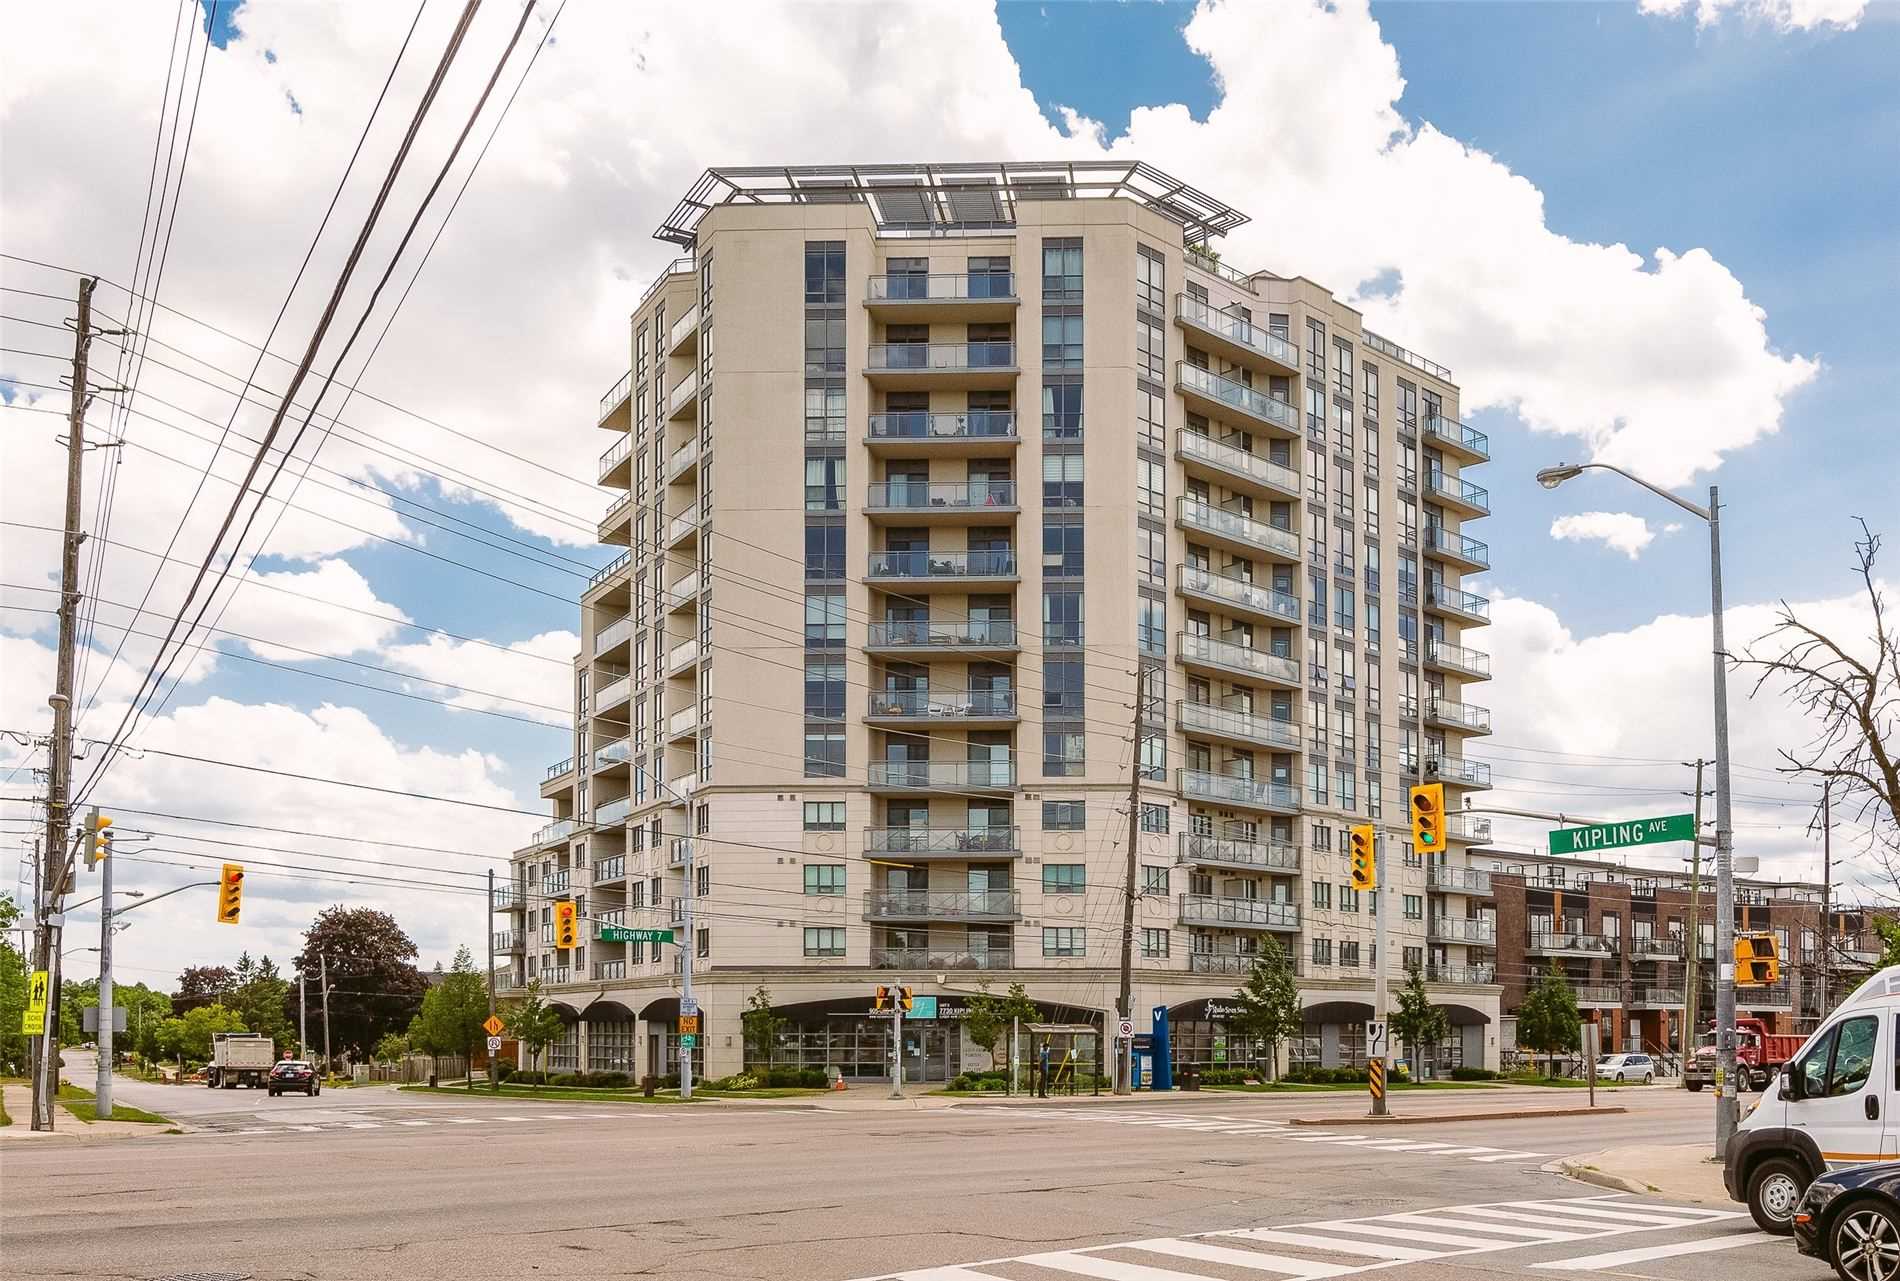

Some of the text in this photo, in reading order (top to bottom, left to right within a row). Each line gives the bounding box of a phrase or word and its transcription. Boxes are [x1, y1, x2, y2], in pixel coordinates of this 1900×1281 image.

[1573, 820, 1668, 849] KIPLING AVE
[613, 930, 663, 941] HIGHWAY 7
[683, 1016, 694, 1025] NO
[1154, 1010, 1162, 1022] V
[681, 1025, 696, 1033] EXIT
